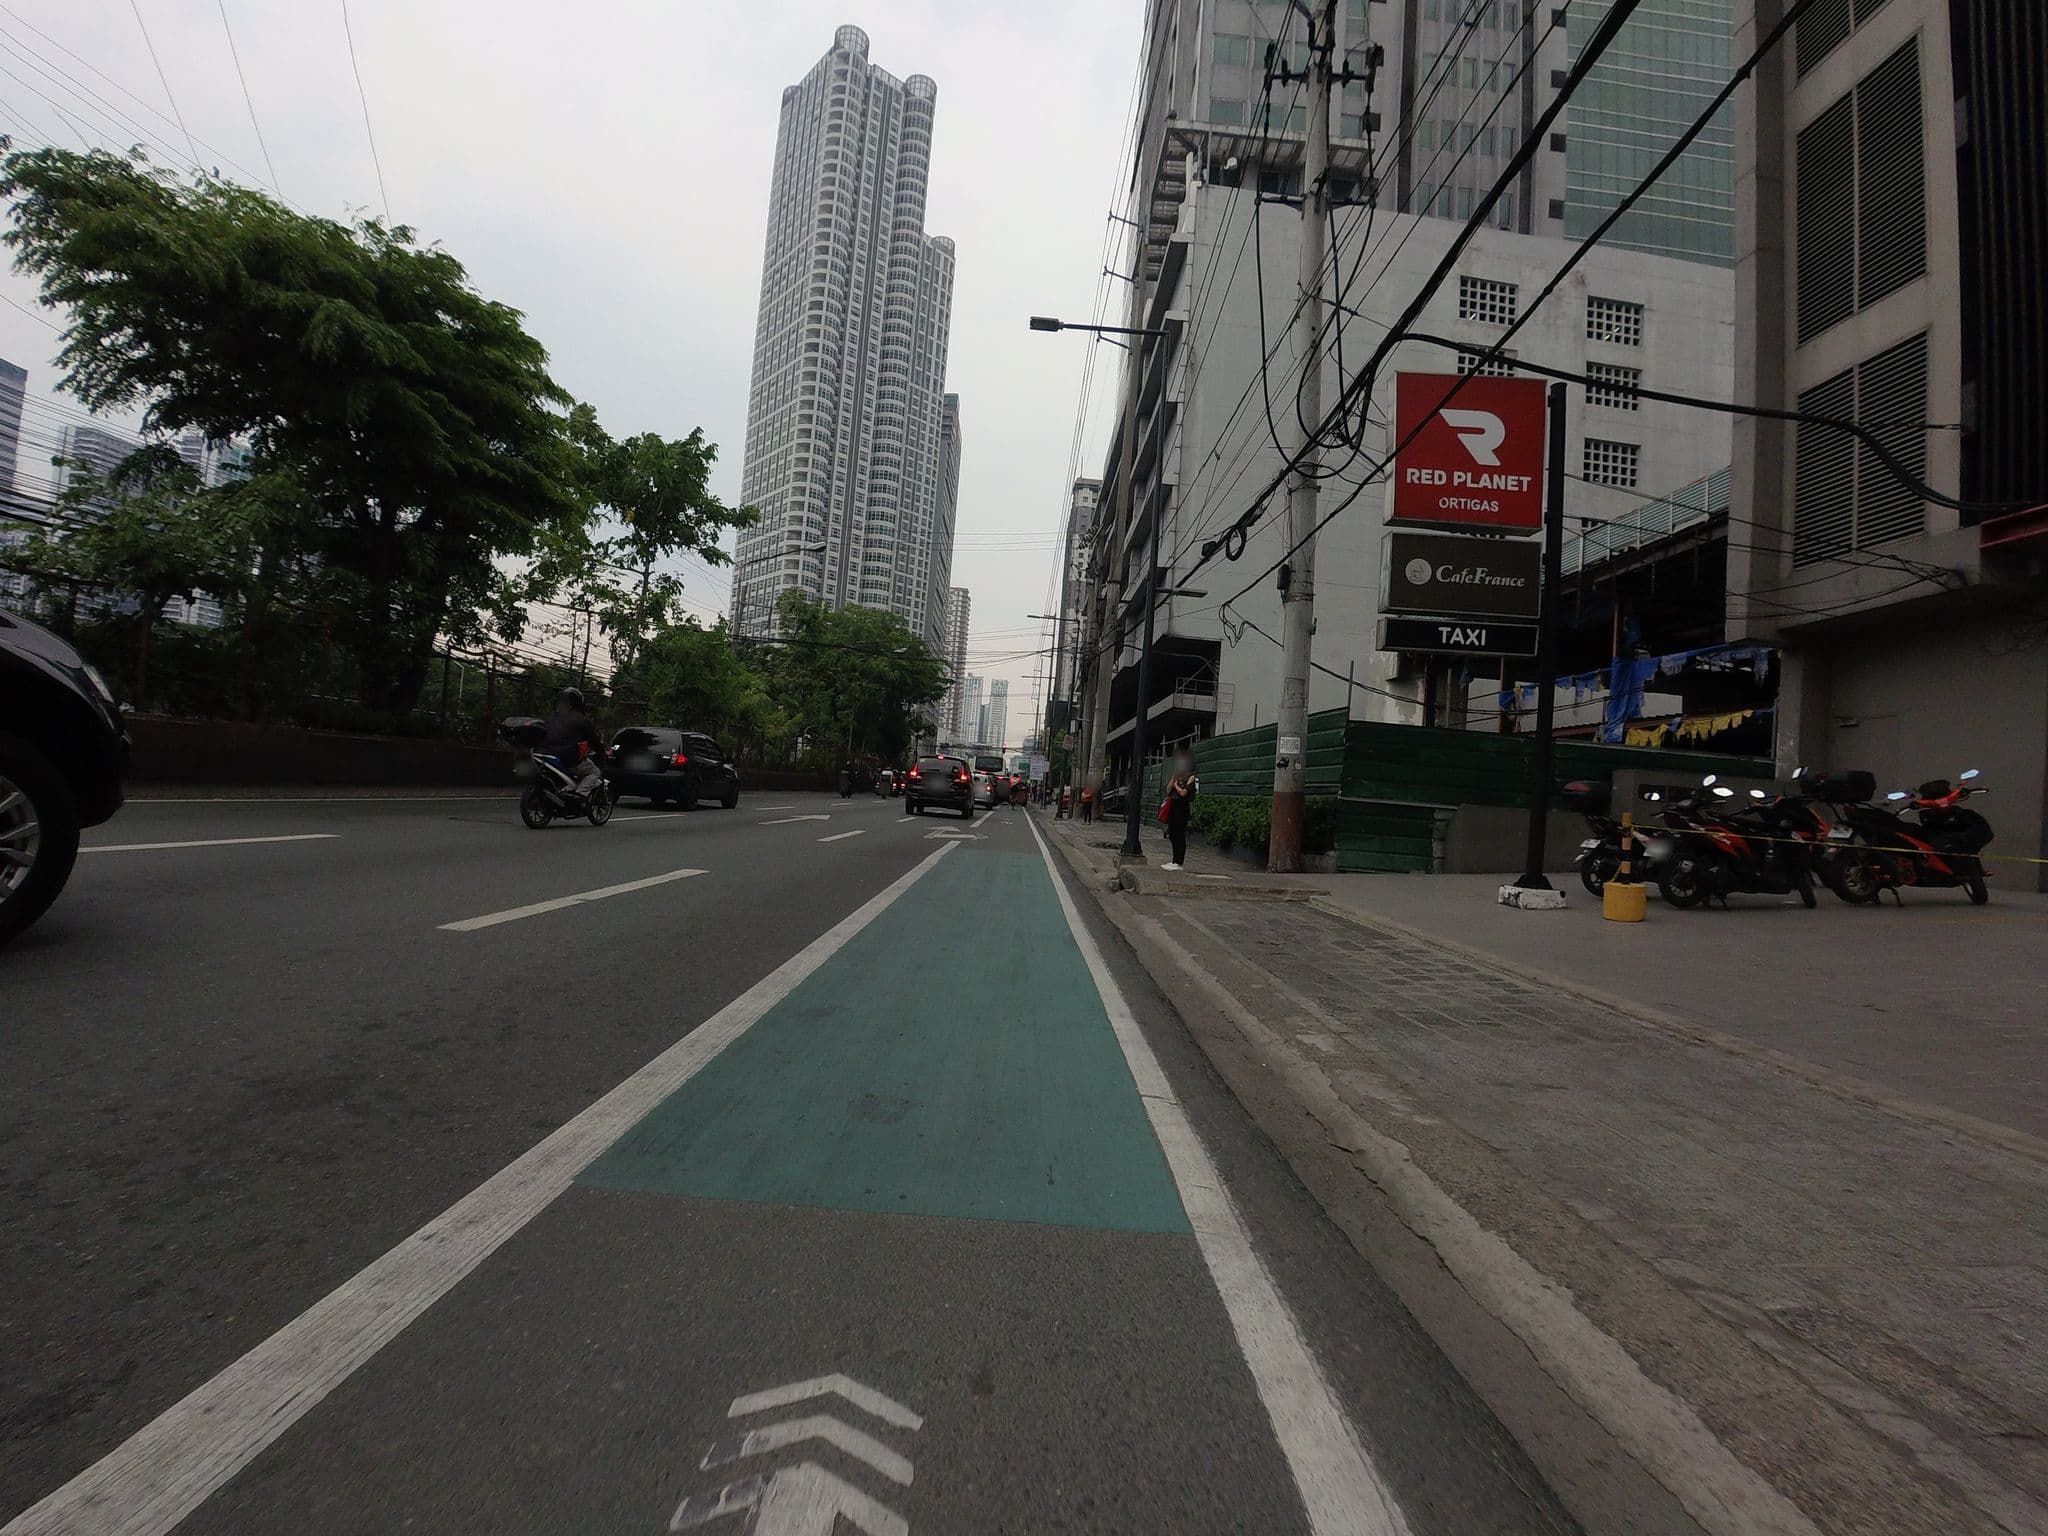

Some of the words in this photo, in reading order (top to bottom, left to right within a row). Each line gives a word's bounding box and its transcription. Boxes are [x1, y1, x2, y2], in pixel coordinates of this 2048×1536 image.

[1406, 468, 1447, 486] RED
[1453, 472, 1532, 492] PLANET
[1439, 497, 1500, 512] ORTIGAS
[1435, 564, 1526, 588] CafeFrance
[1438, 626, 1487, 646] TAXI
